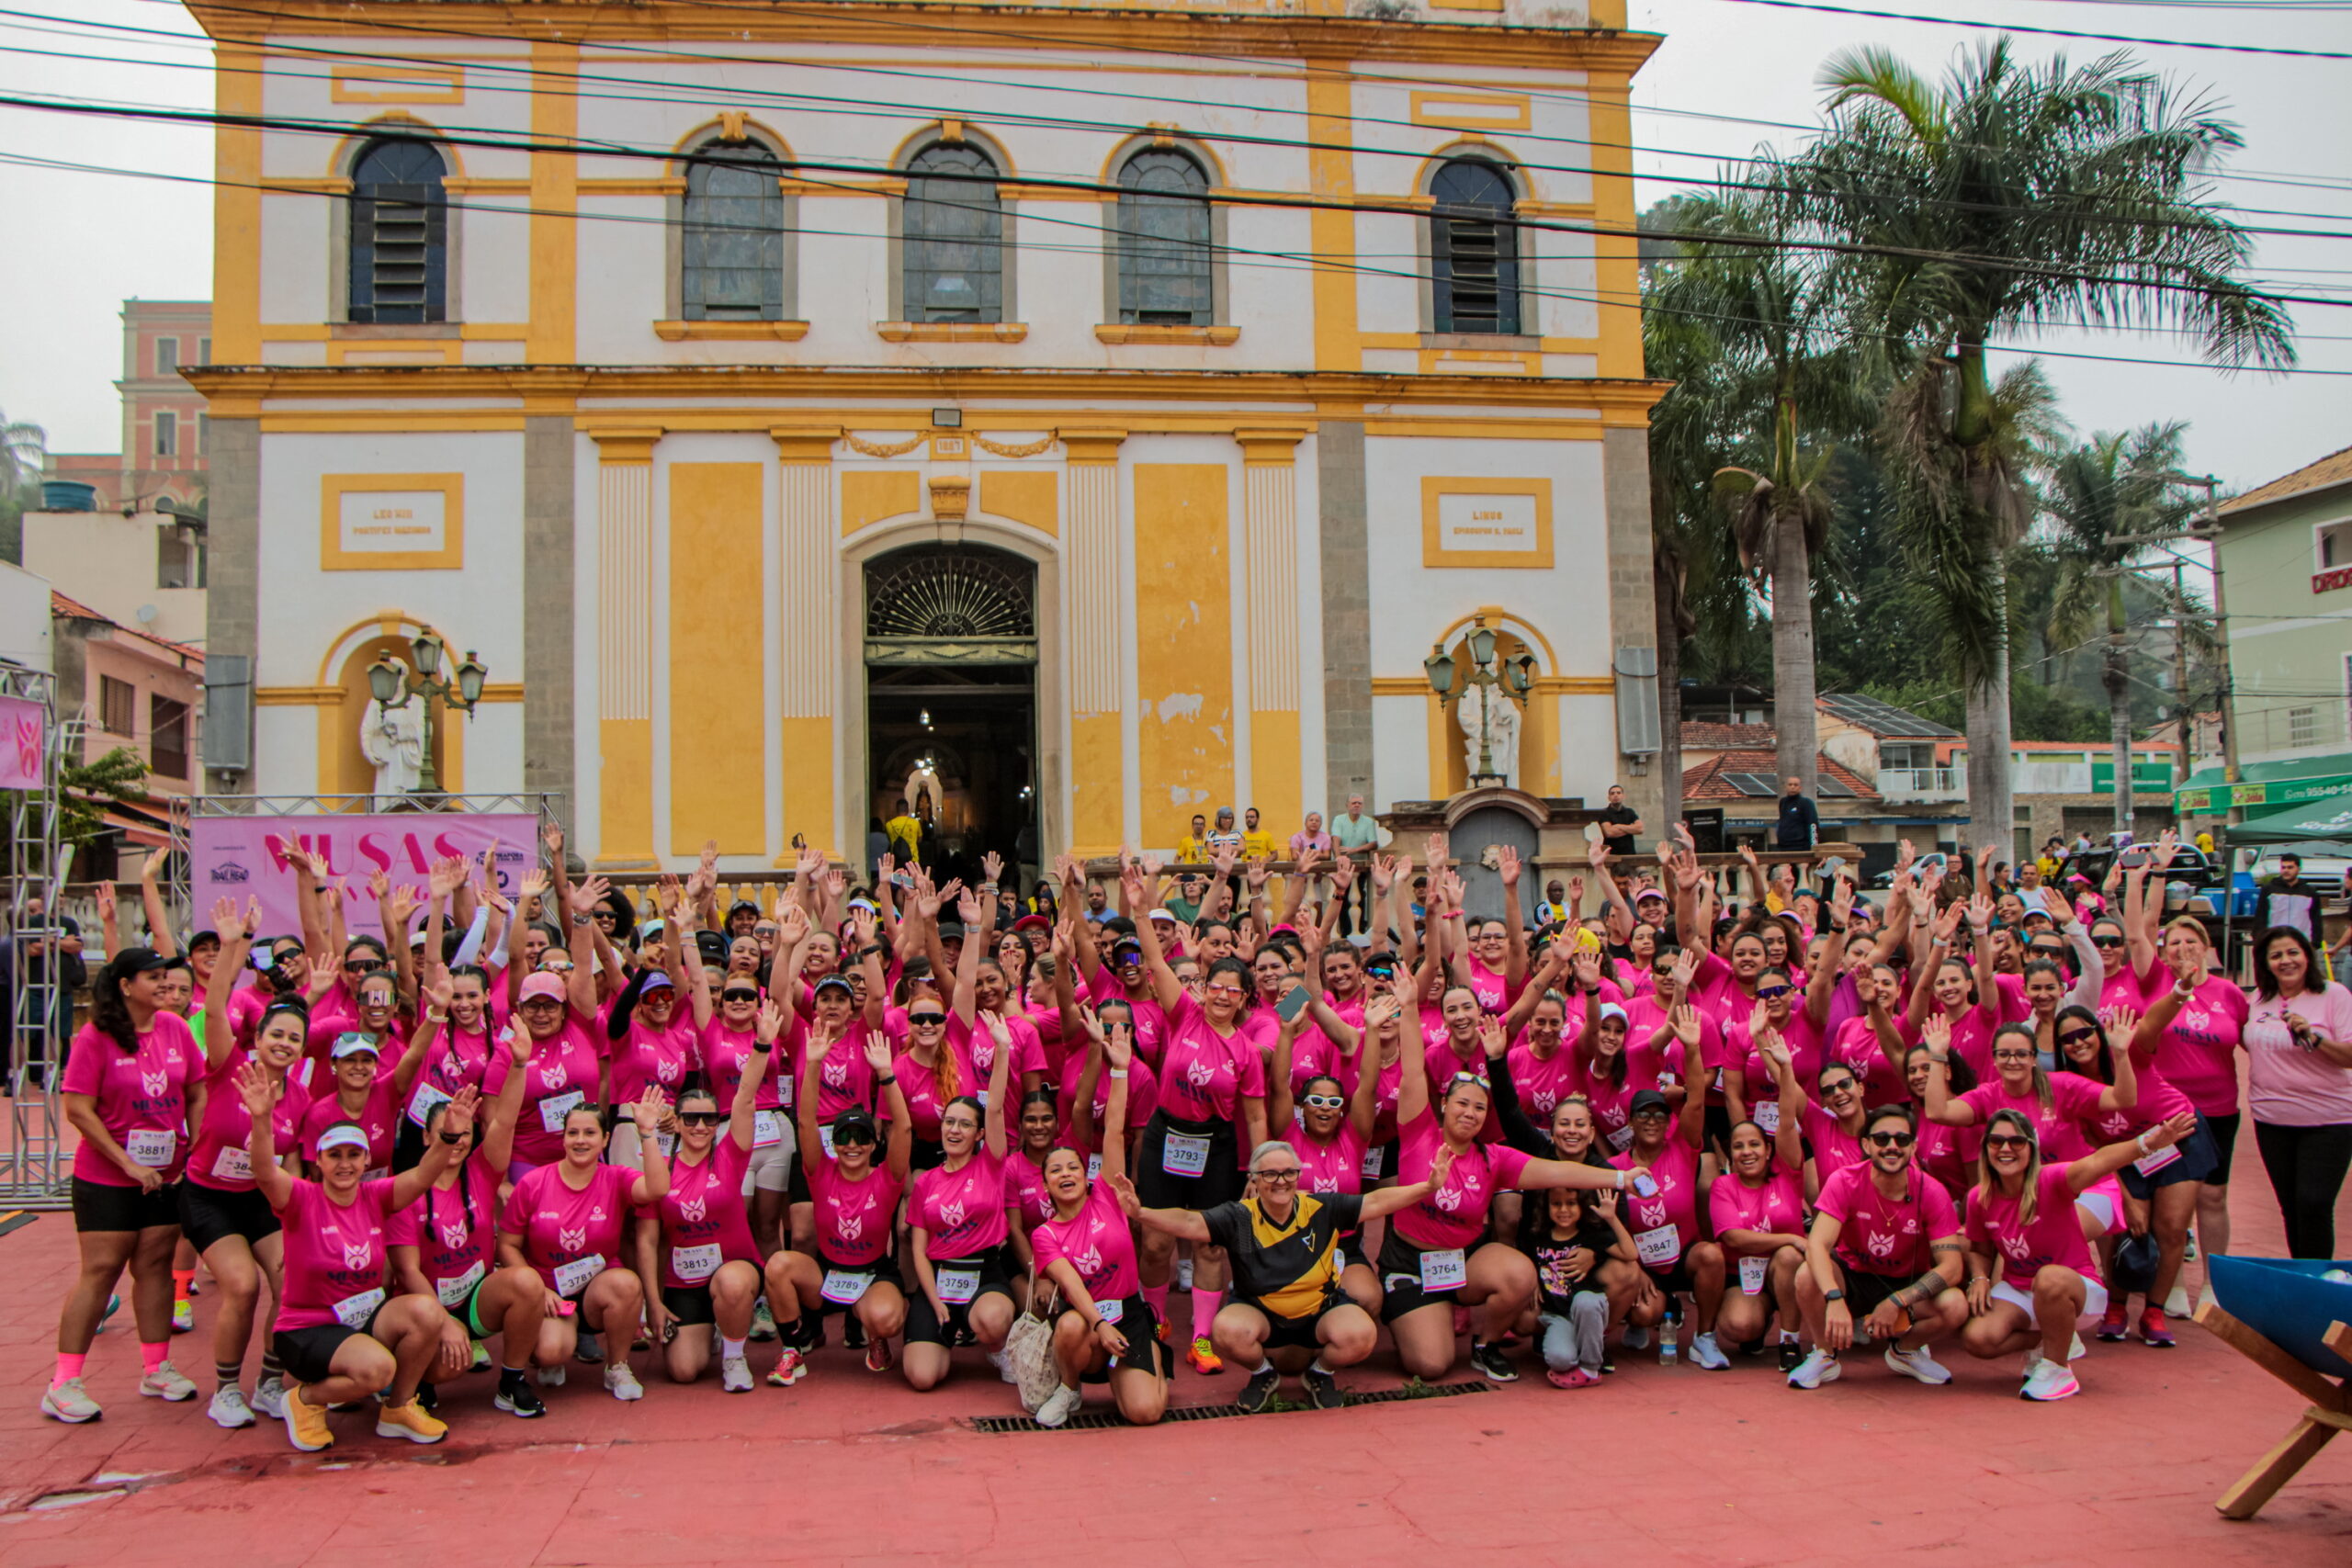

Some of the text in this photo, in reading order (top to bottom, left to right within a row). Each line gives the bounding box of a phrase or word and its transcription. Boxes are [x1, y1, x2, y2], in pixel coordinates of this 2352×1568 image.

[2311, 567, 2352, 594] DRO
[137, 1145, 165, 1156] 3881
[1173, 1149, 1199, 1162] 3793
[1646, 1239, 1671, 1254] 3847
[682, 1258, 709, 1269] 3813
[1431, 1263, 1457, 1276] 3764
[568, 1270, 594, 1288] 3781
[834, 1280, 859, 1291] 3789
[944, 1278, 970, 1289] 3759
